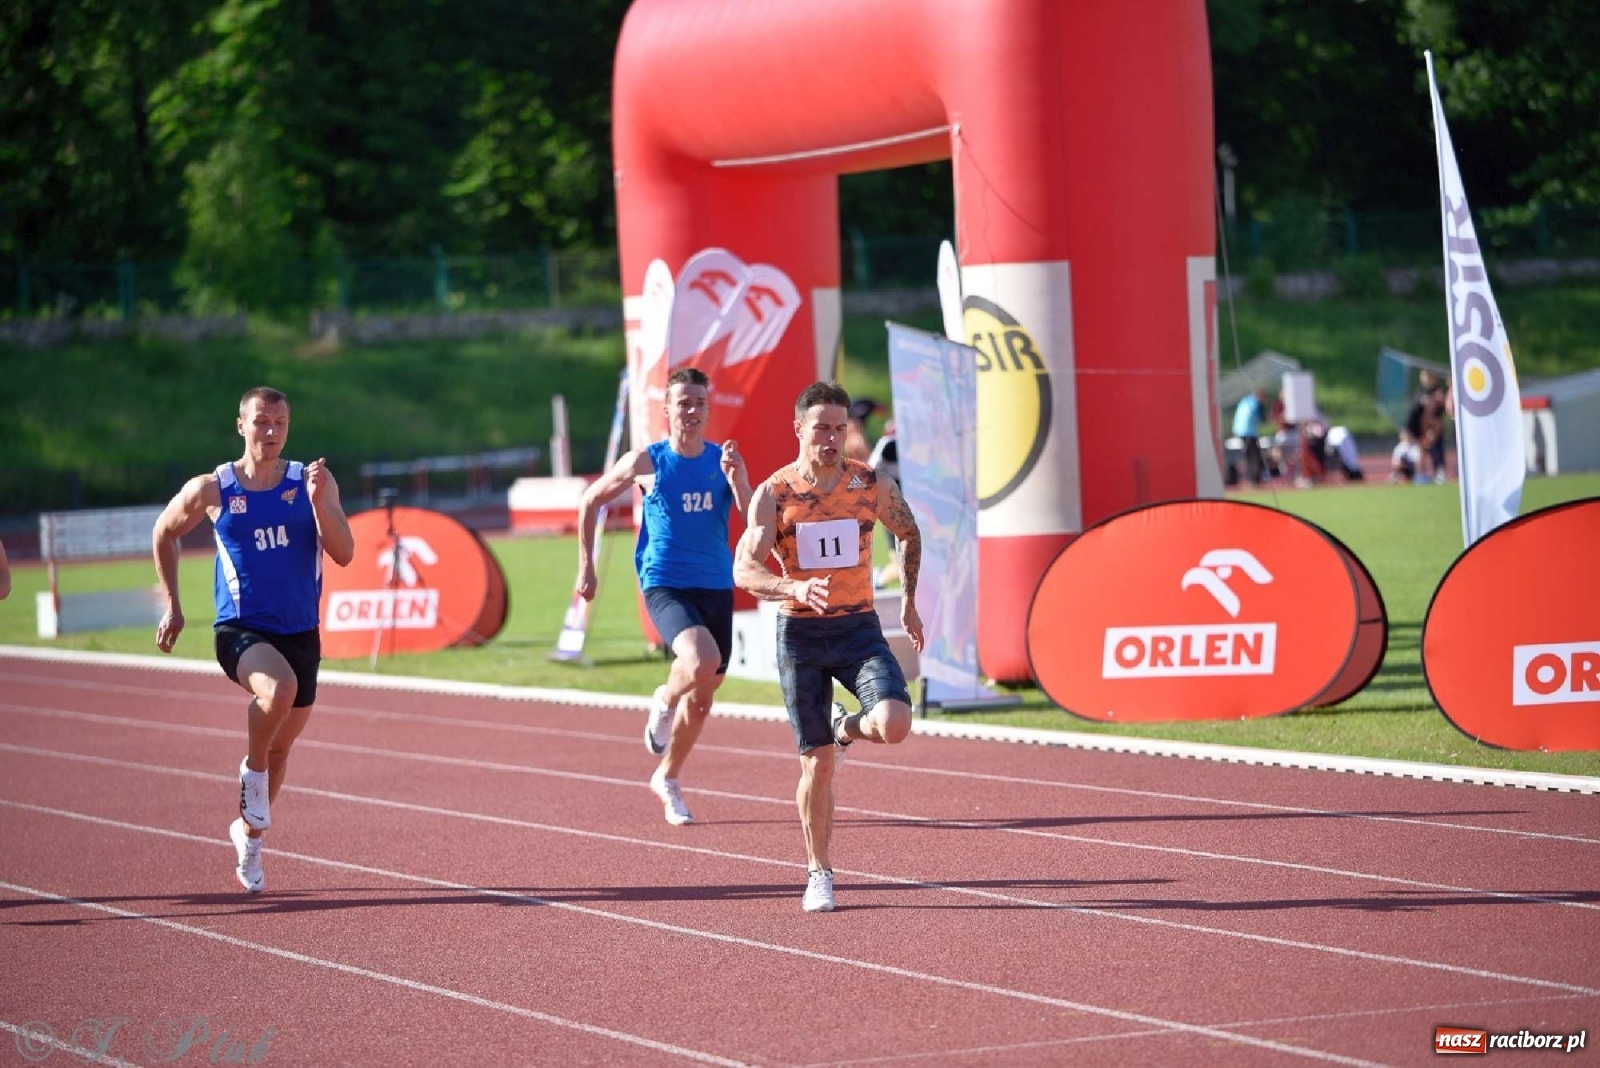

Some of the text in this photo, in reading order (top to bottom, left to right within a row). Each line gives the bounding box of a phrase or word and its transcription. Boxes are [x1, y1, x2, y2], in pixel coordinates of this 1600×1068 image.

[682, 492, 713, 513] 324
[254, 525, 290, 551] 314
[817, 535, 842, 558] 11
[1115, 632, 1264, 669] ORLEN
